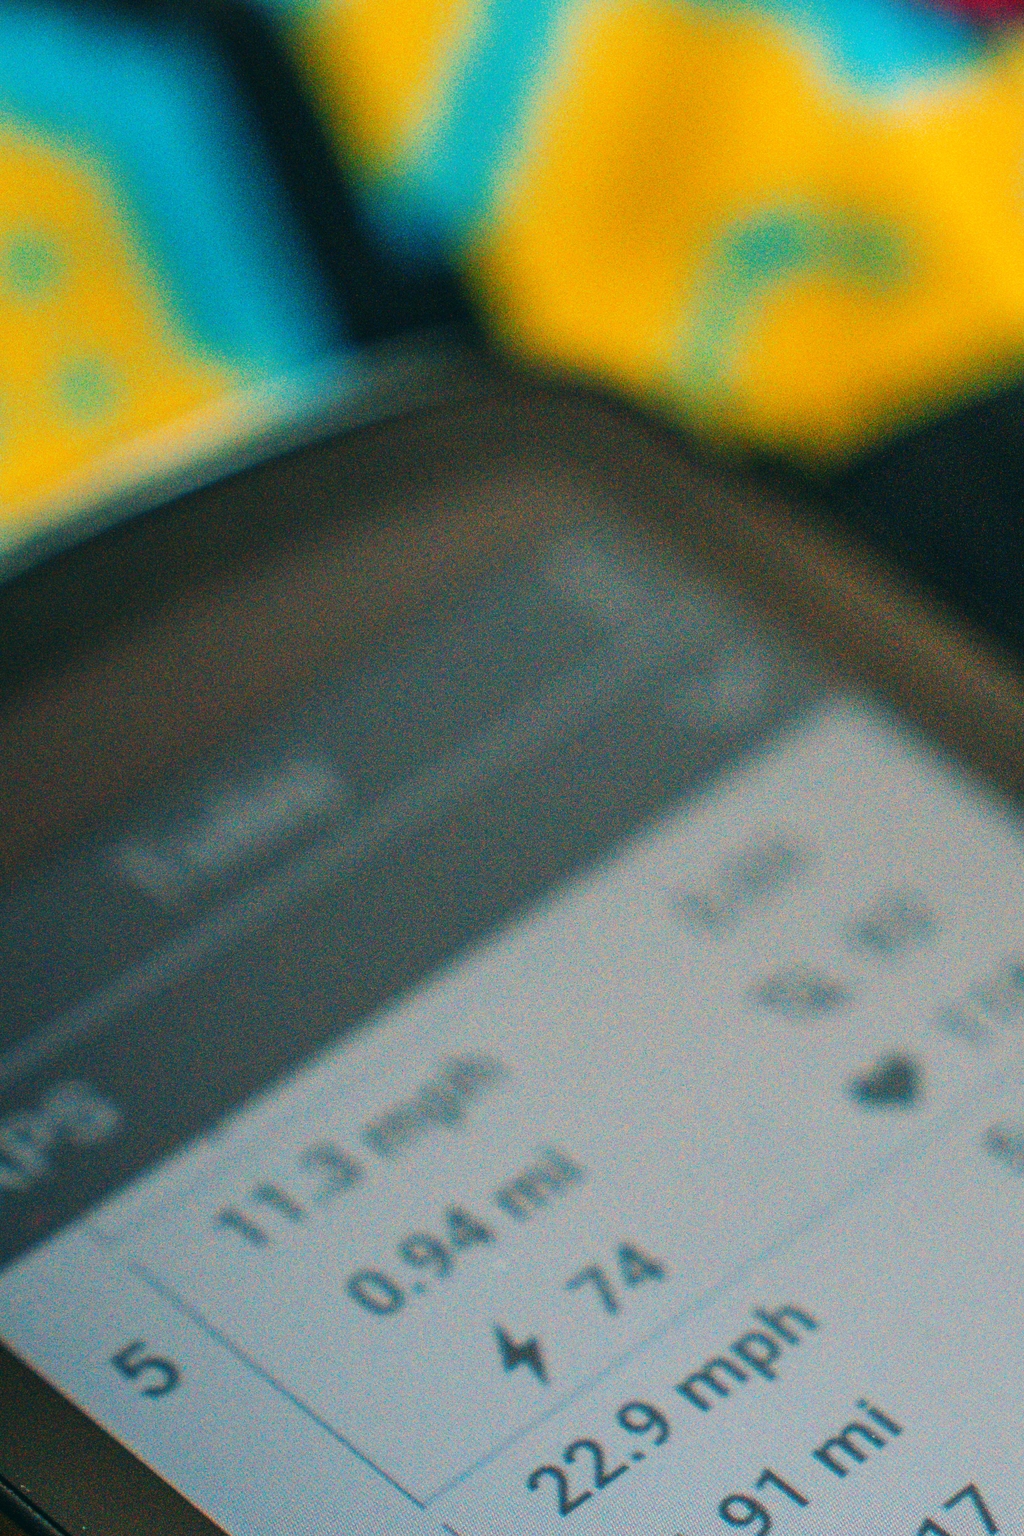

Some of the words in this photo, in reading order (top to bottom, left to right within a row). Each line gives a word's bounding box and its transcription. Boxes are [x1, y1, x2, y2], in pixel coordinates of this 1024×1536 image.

[215, 1143, 365, 1248] 11.3
[346, 1205, 496, 1316] 0.94
[497, 1148, 588, 1220] mi
[567, 1242, 668, 1316] 74
[111, 1339, 182, 1398] 5
[526, 1400, 672, 1518] 22.9
[675, 1302, 821, 1412] mph
[812, 1399, 903, 1479] mi
